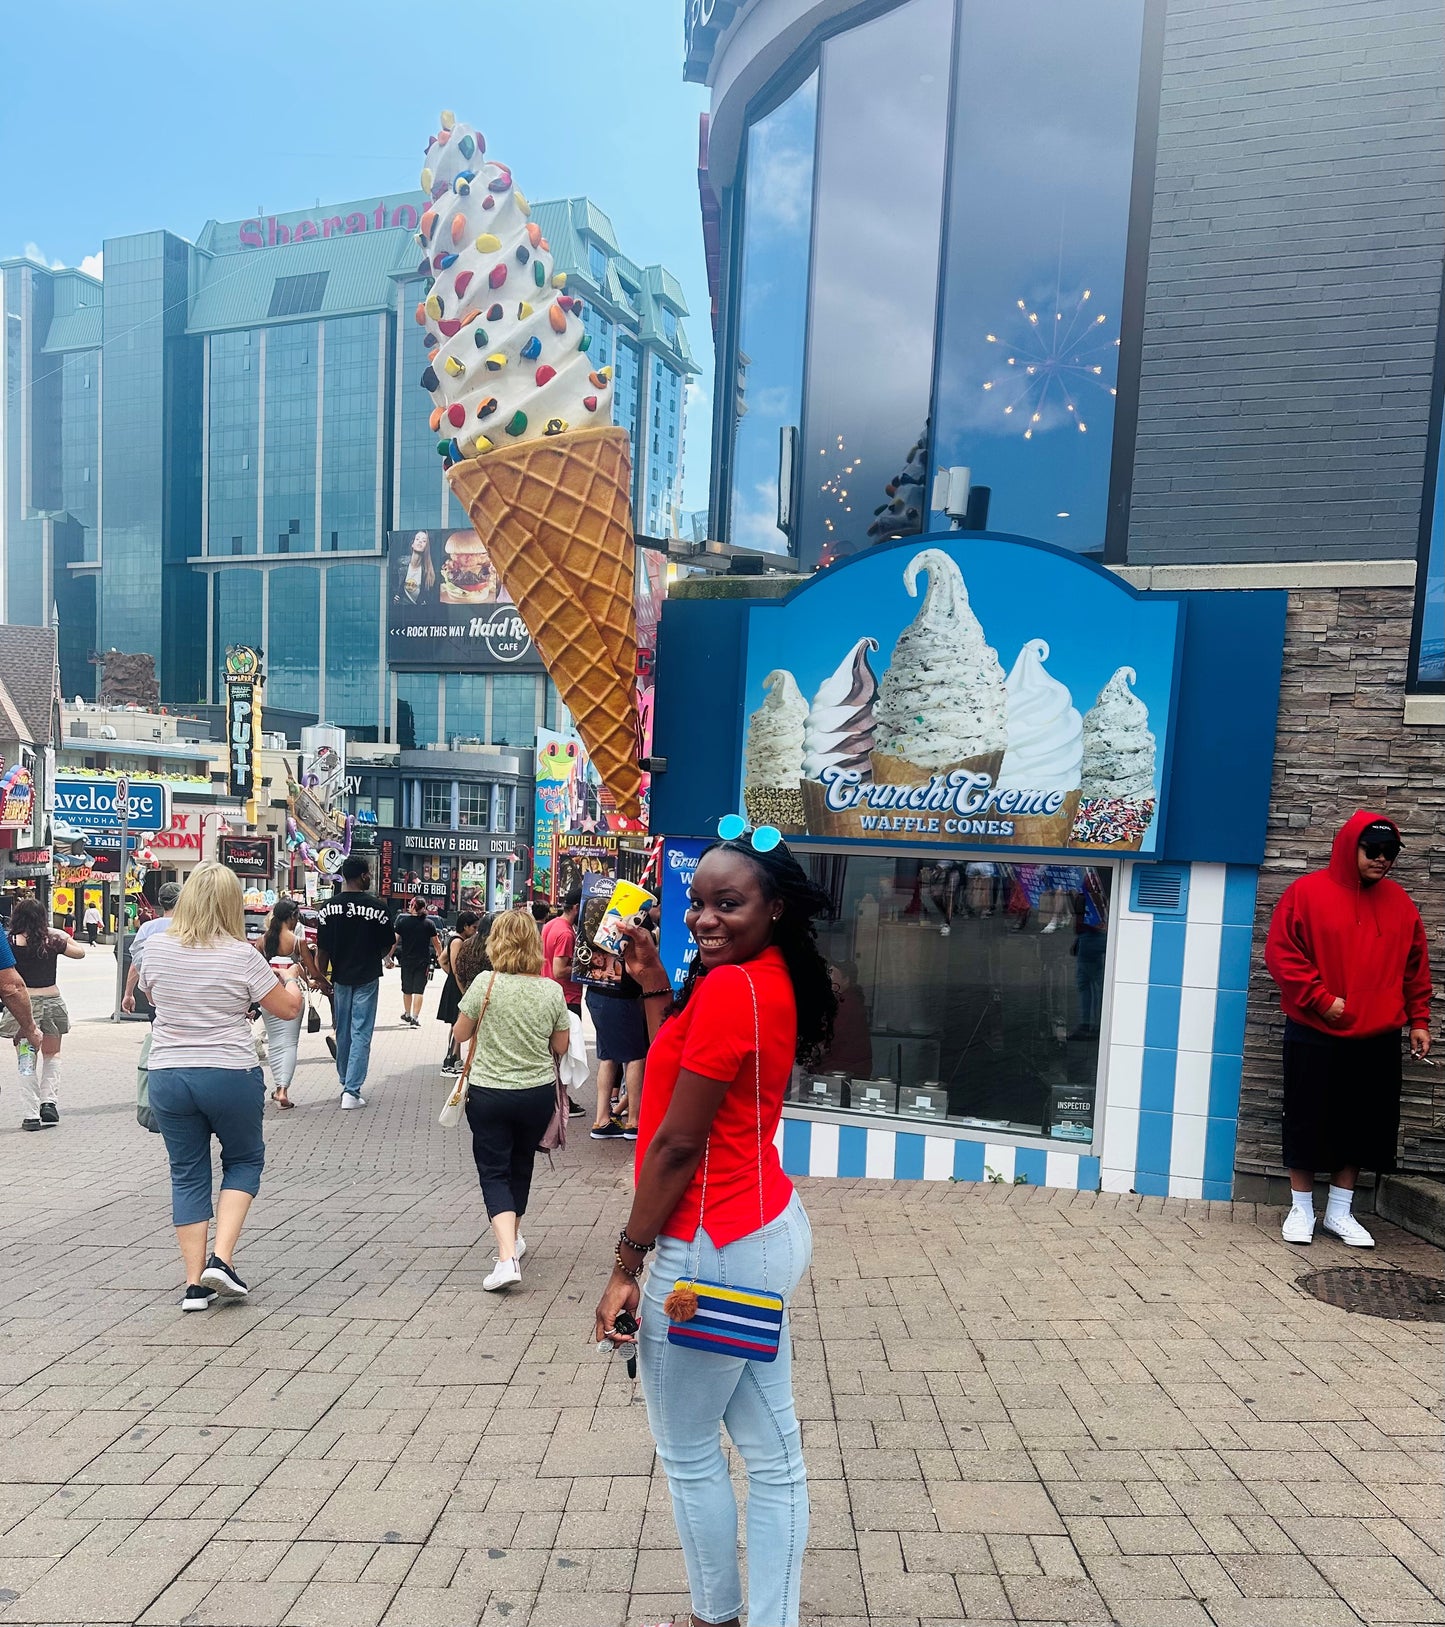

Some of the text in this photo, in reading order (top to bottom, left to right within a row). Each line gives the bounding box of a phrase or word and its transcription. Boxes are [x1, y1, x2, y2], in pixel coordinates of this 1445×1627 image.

[406, 626, 465, 637] ROCK THIS WAY
[469, 617, 509, 638] Hard
[498, 642, 518, 651] CAFE
[232, 701, 251, 786] PUTT
[859, 815, 1015, 836] WAFFLE CONES
[94, 837, 120, 847] Falls
[405, 835, 479, 851] DISTILLERY & BBQ
[558, 834, 617, 851] MOVIELAND
[230, 848, 252, 857] Ruby
[227, 855, 264, 866] Tuesday
[382, 840, 392, 896] BEER STORE
[462, 861, 485, 875] 4D
[423, 884, 429, 894] &
[431, 884, 447, 895] BBQ
[346, 902, 389, 925] Angels
[1057, 1101, 1091, 1111] INSPECTED
